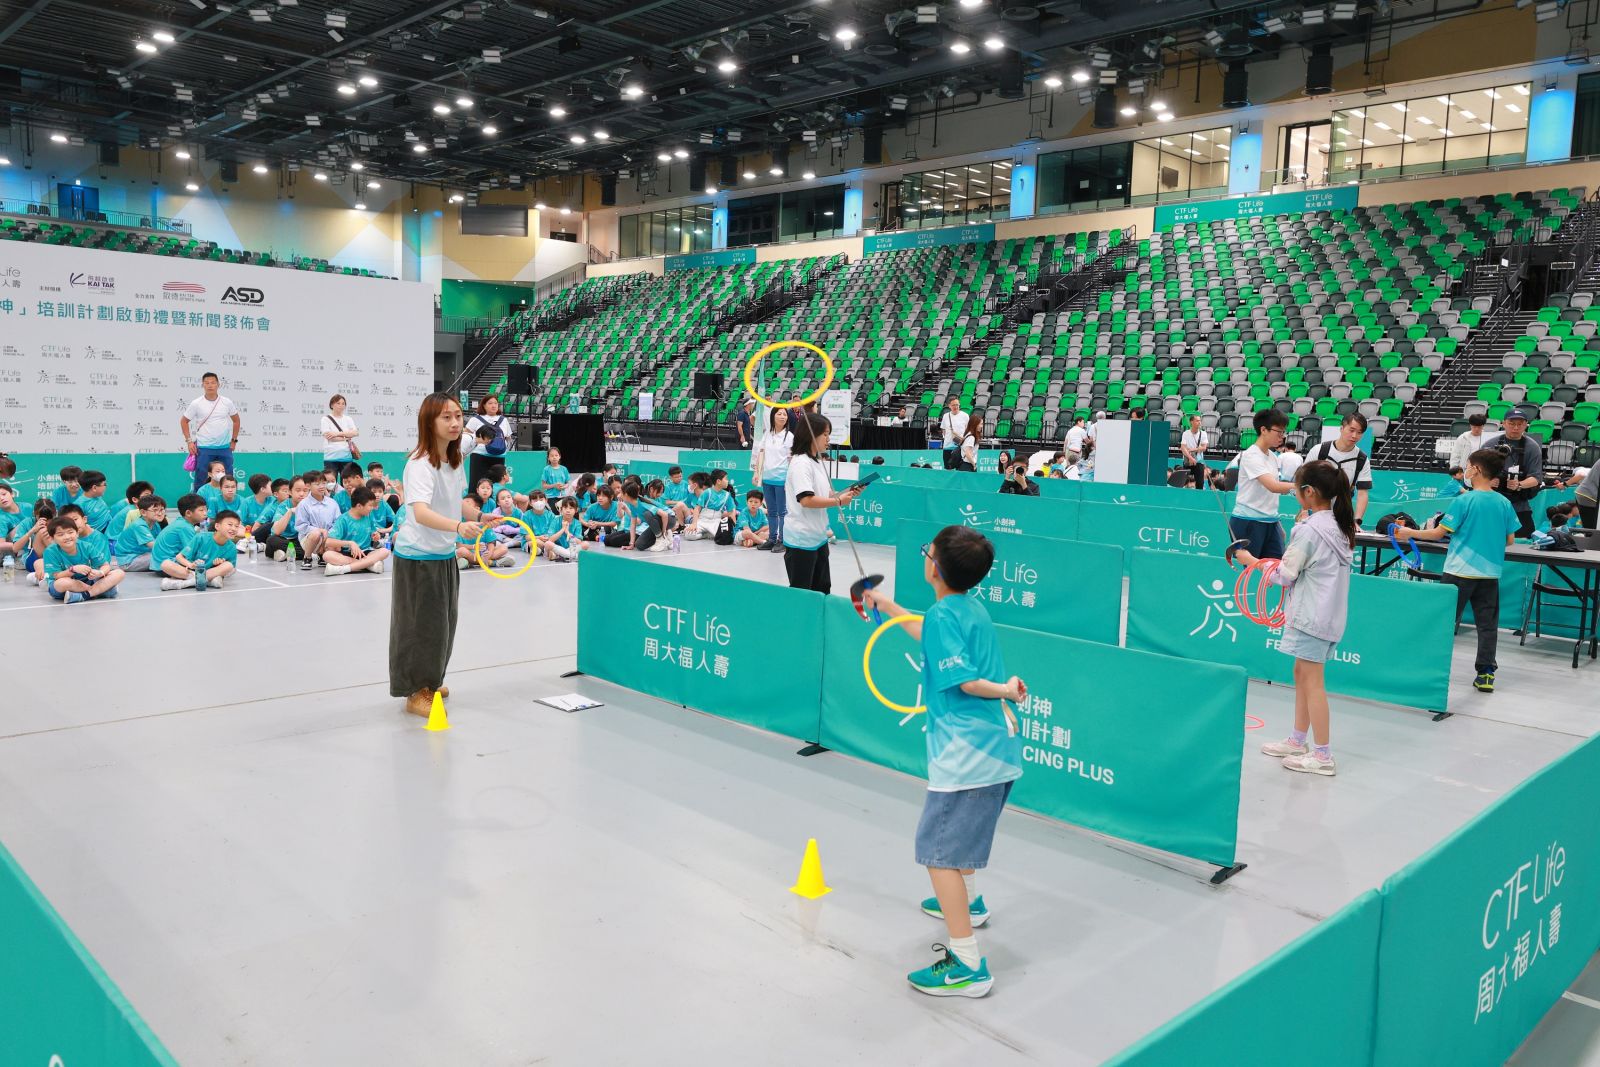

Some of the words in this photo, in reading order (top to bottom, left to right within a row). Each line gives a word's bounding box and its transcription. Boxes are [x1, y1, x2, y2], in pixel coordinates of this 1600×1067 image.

[220, 286, 264, 304] ASD
[839, 498, 861, 511] TF
[1138, 526, 1176, 544] CTF
[1179, 528, 1210, 548] Life
[1003, 560, 1038, 585] Life
[968, 582, 1036, 608] 大福人壽
[643, 602, 688, 635] CTF
[692, 610, 731, 646] Life
[642, 636, 730, 679] 周大福人壽
[1333, 649, 1361, 665] LUS
[1016, 693, 1053, 719] 創神
[1020, 717, 1071, 750] 計劃
[1022, 745, 1064, 770] CING
[1067, 757, 1114, 785] PLUS
[1481, 860, 1532, 950] CTF
[1532, 839, 1566, 905] Life
[1473, 902, 1562, 1025] 周大福人壽
